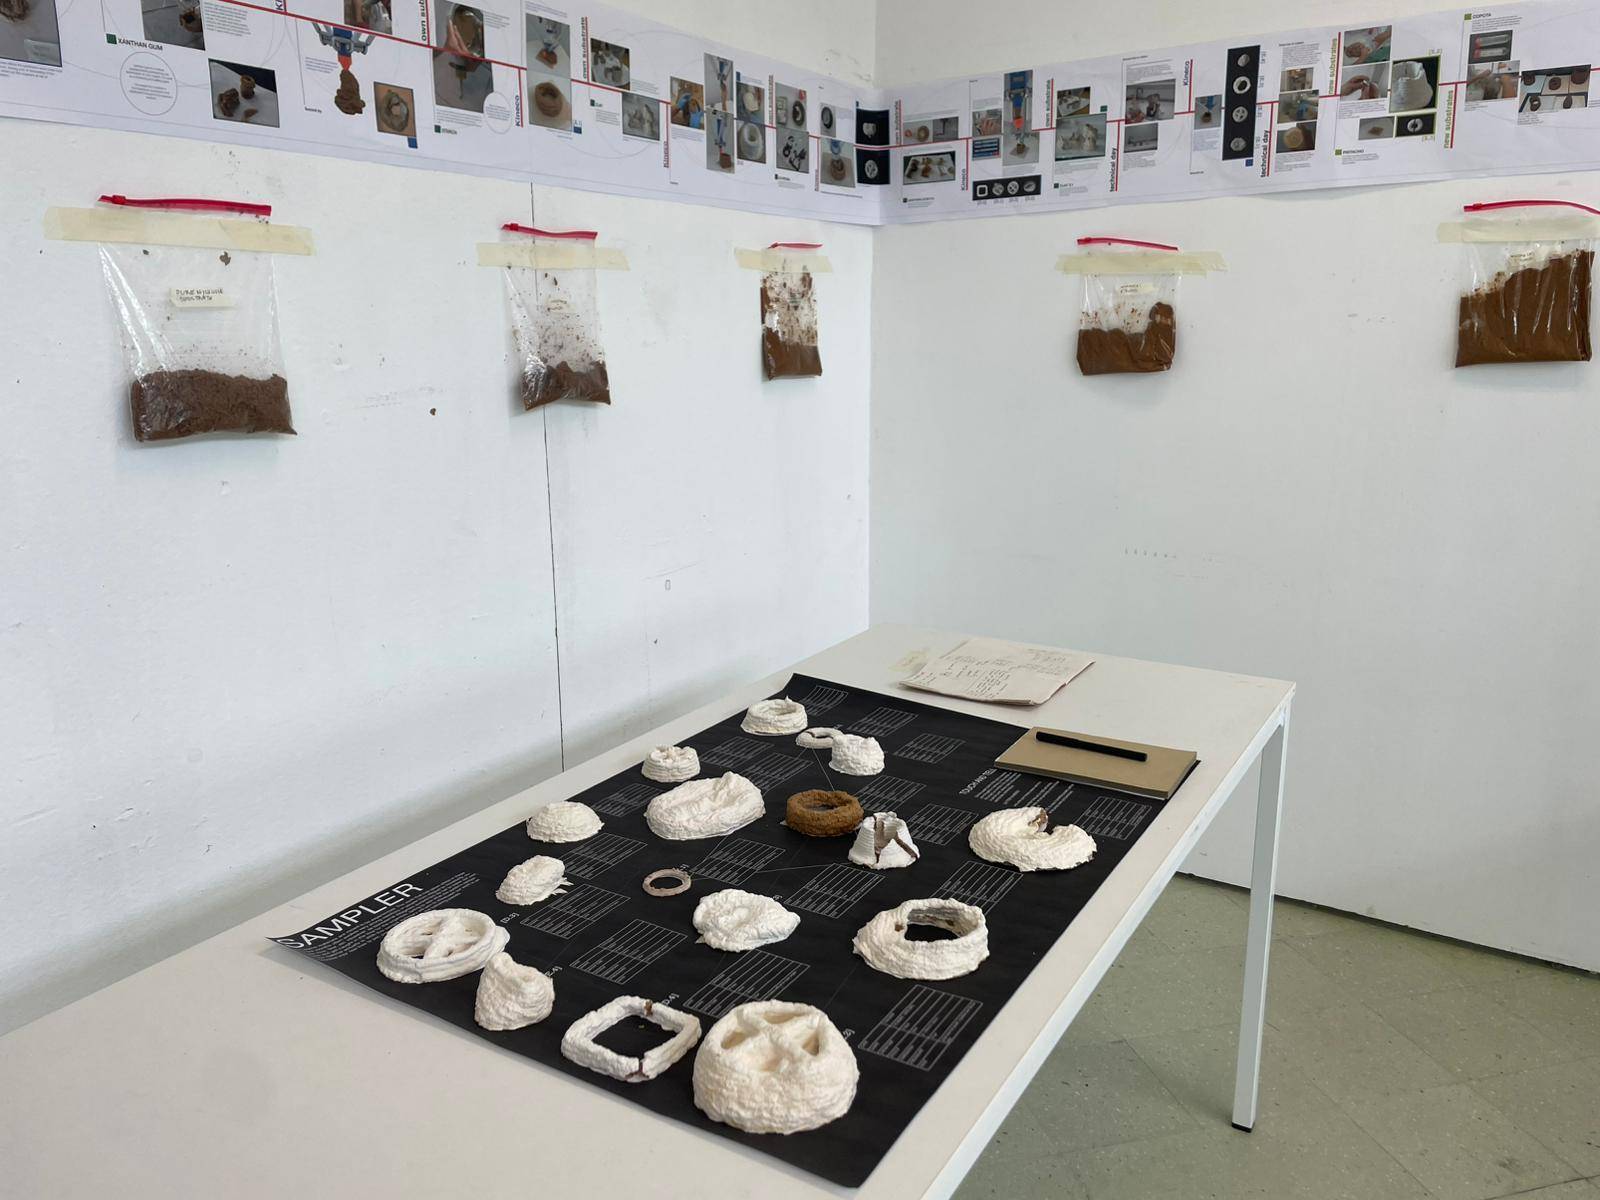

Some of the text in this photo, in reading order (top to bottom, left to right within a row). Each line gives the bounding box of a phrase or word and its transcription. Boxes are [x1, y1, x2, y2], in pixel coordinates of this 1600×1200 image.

[118, 38, 163, 51] XANTHAN GUM
[1329, 38, 1338, 78] substrates
[1262, 130, 1270, 144] day
[1443, 90, 1454, 149] new substrates
[1260, 145, 1268, 178] technical
[276, 883, 423, 949] SAMPLER
